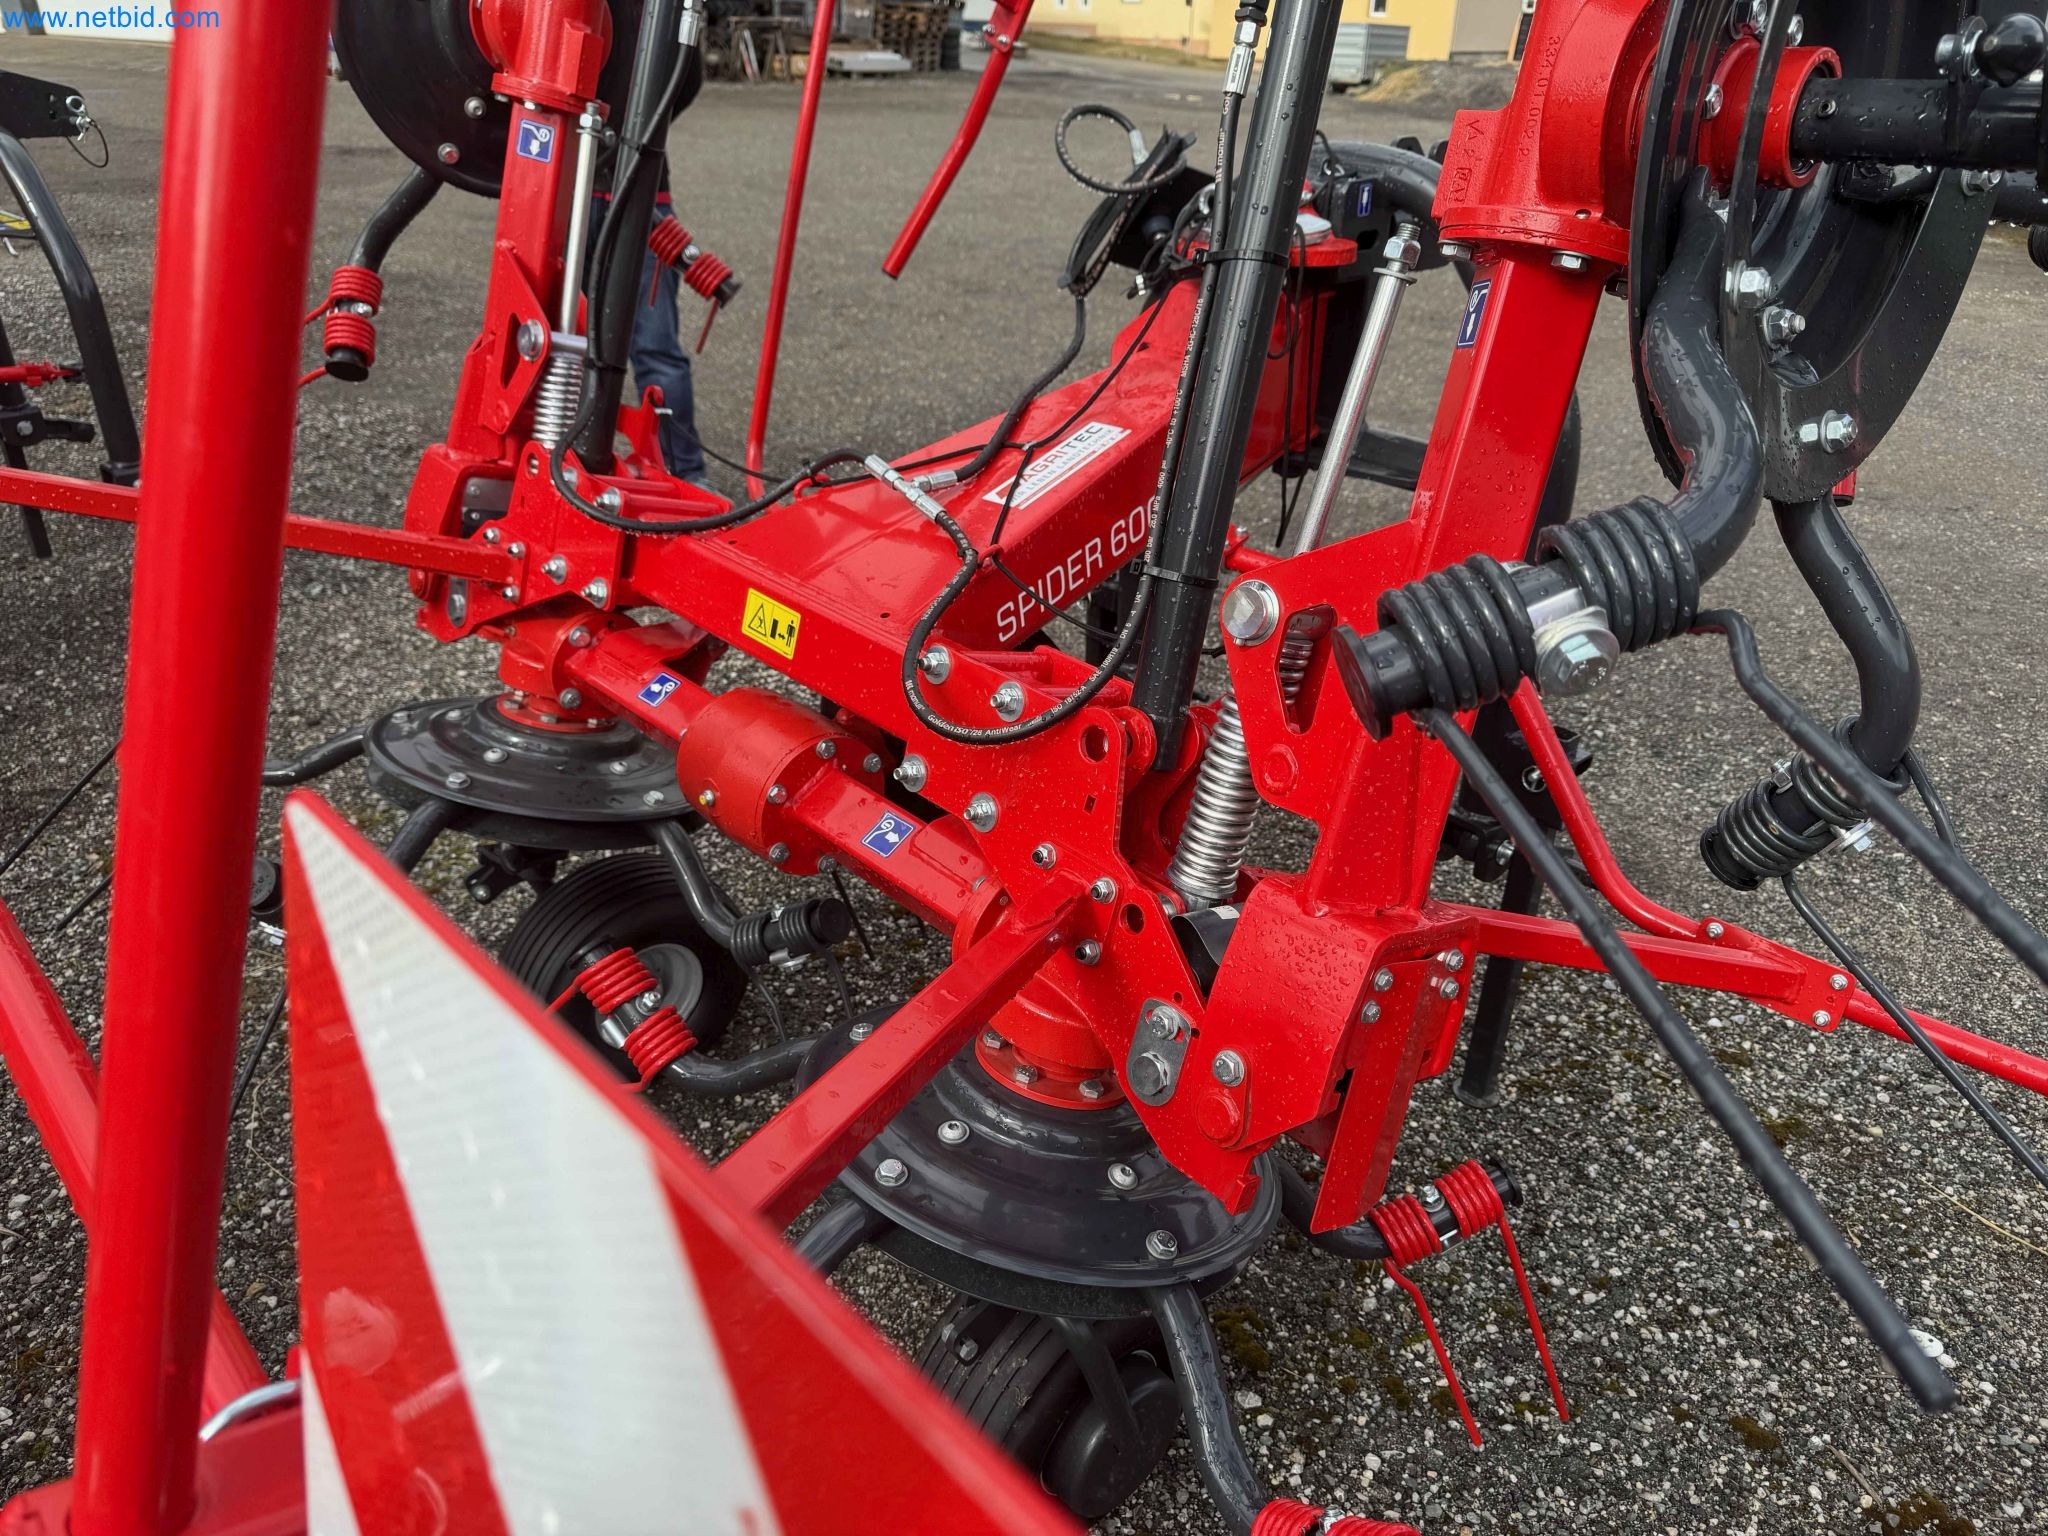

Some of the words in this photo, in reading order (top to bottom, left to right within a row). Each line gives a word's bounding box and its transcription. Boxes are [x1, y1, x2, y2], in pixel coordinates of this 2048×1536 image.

[1020, 425, 1103, 482] AGRITEC
[1051, 704, 1063, 714] ISO
[1089, 668, 1103, 682] SAE
[1153, 496, 1161, 512] MPa
[1181, 355, 1191, 378] MSHA
[996, 537, 1103, 642] SPIDER
